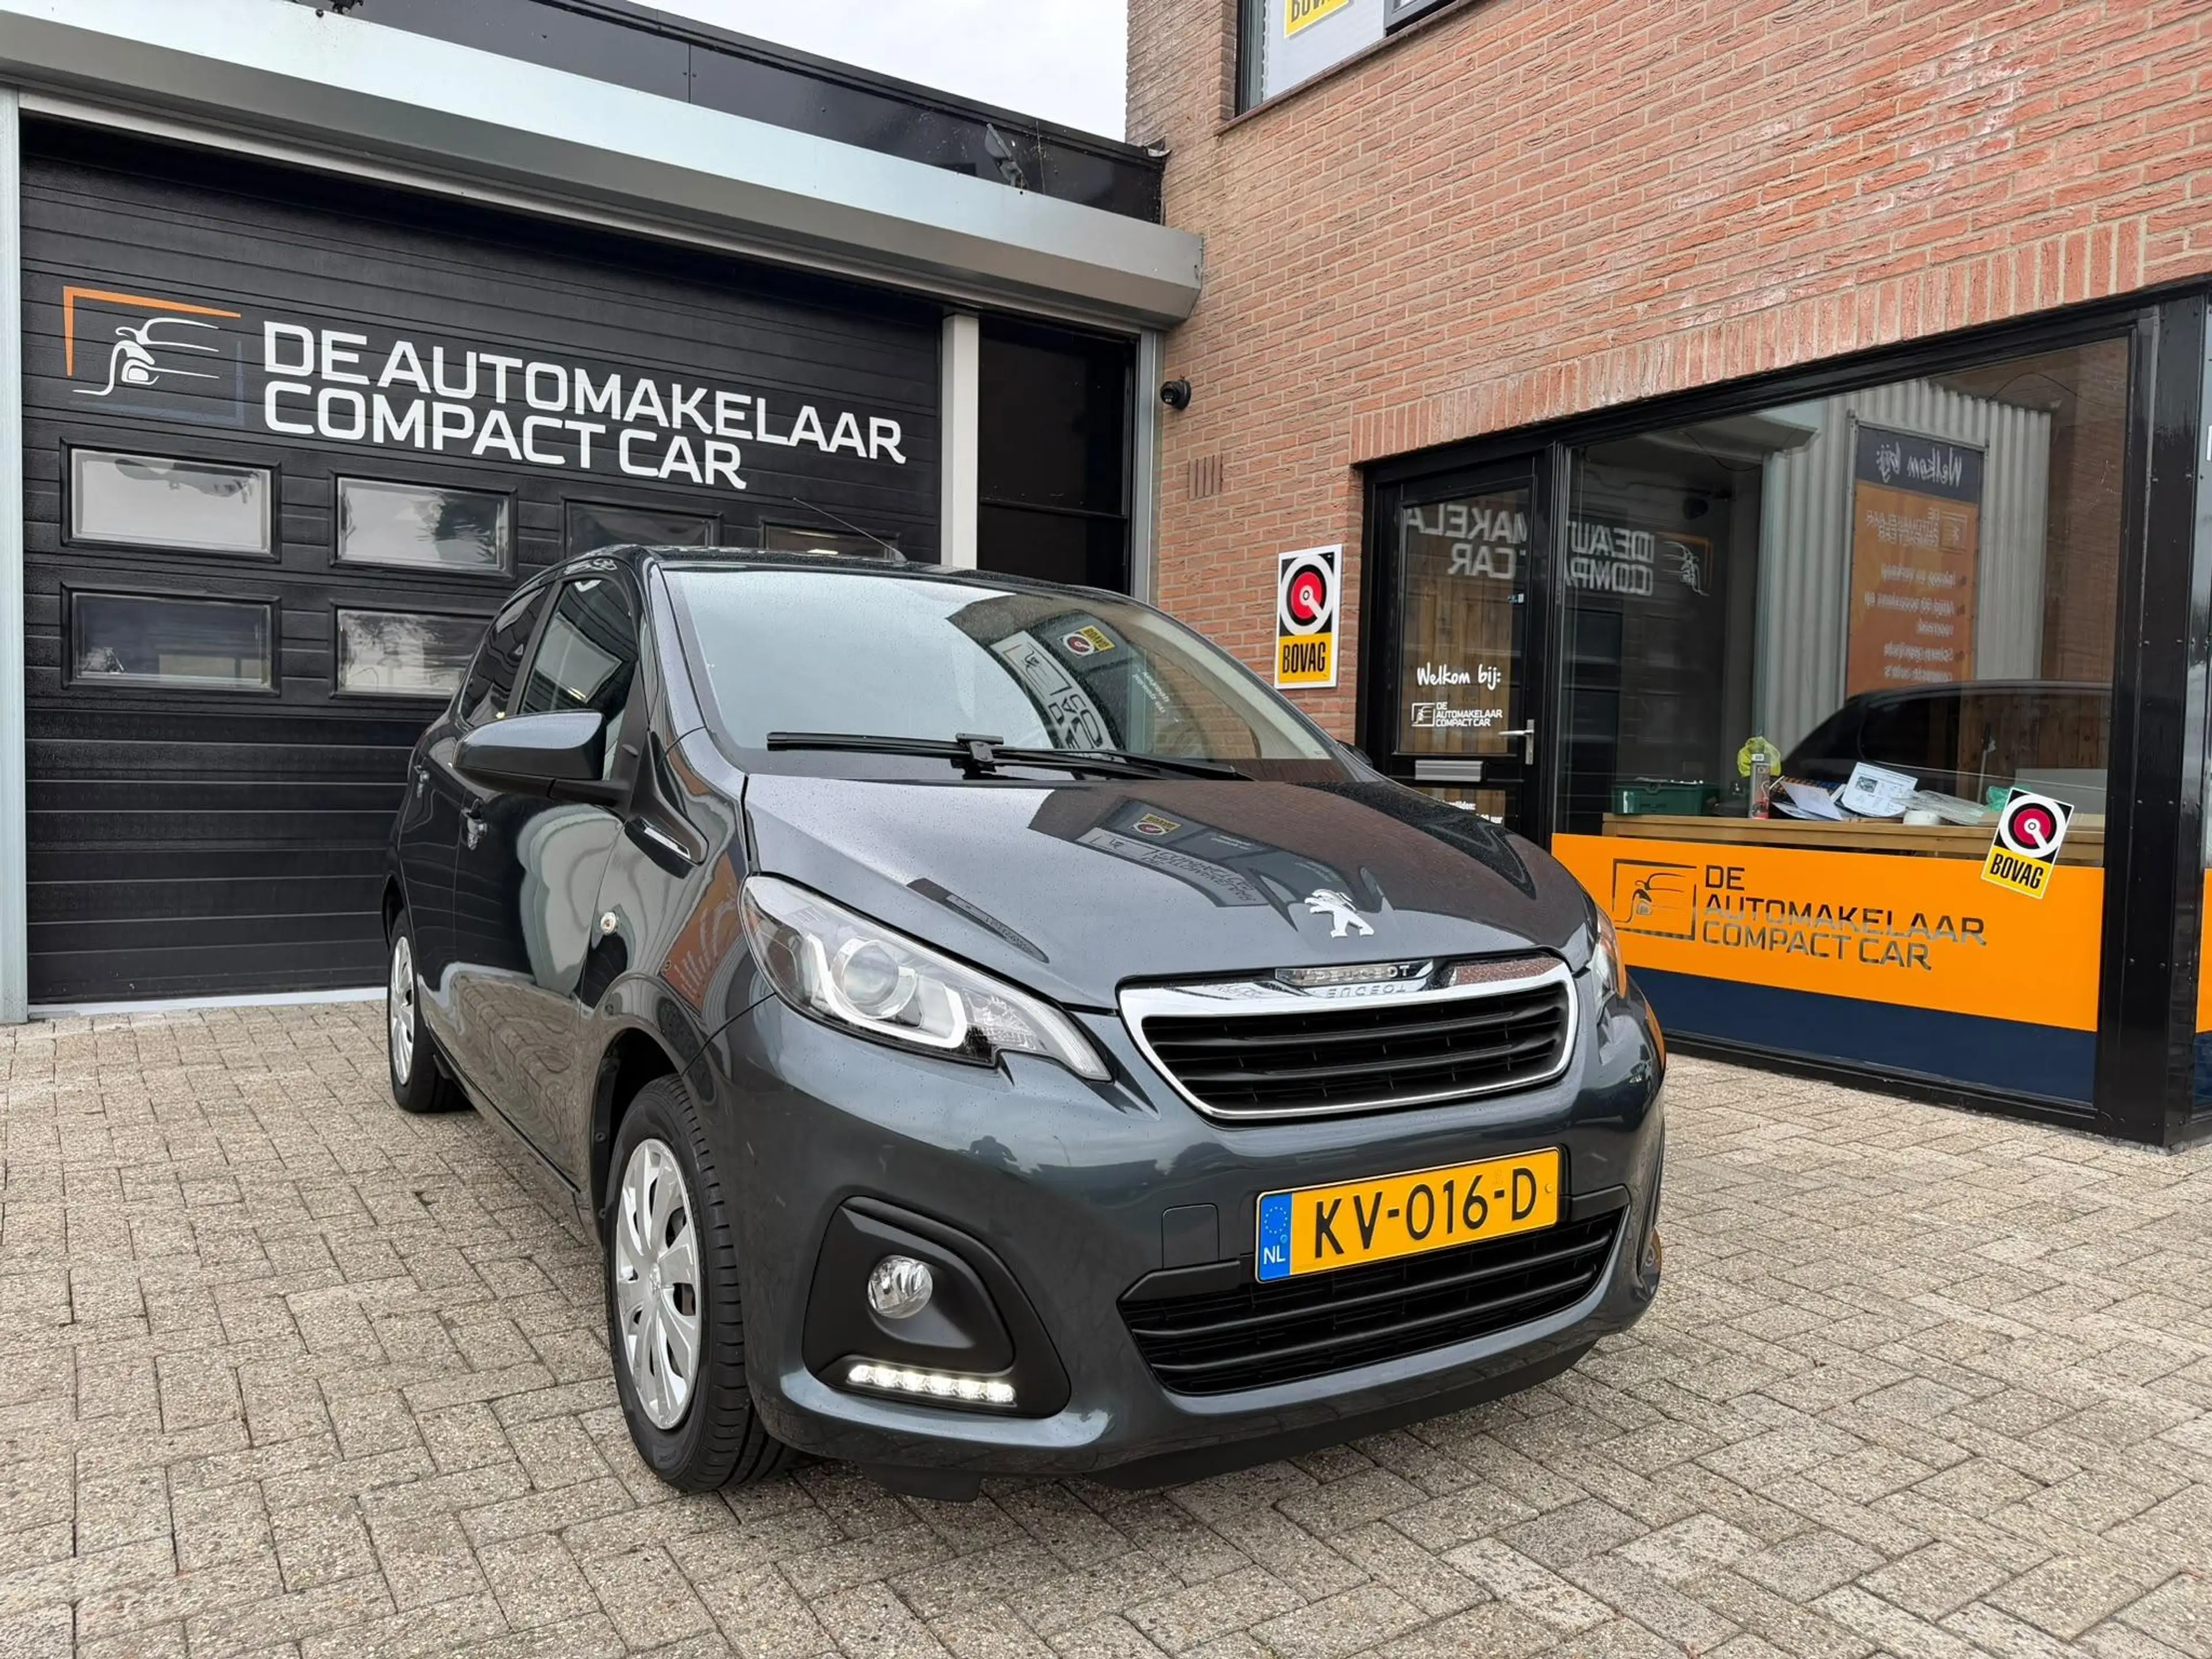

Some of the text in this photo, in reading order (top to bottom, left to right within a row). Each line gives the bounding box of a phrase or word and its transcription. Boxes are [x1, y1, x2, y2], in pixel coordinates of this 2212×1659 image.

[264, 321, 906, 464] DE AUTOMAKELAAR
[264, 380, 747, 490] COMPACT CAR
[1283, 642, 1326, 673] BOVAG
[1416, 661, 1502, 691] Welkom bij:
[1435, 709, 1503, 718] AUTOMAKELAAR
[1436, 702, 1448, 710] DE
[1435, 718, 1491, 727] COMPACT CAR
[1706, 865, 1745, 891] DE
[1990, 853, 2044, 889] BOVAG
[1703, 893, 1987, 946] AUTOMAKELAAR
[1703, 921, 1932, 971] COMPACT CAR
[1315, 965, 1410, 983] PEUGEOT
[1315, 1167, 1537, 1259] KV-016-D
[1263, 1245, 1286, 1265] NL
